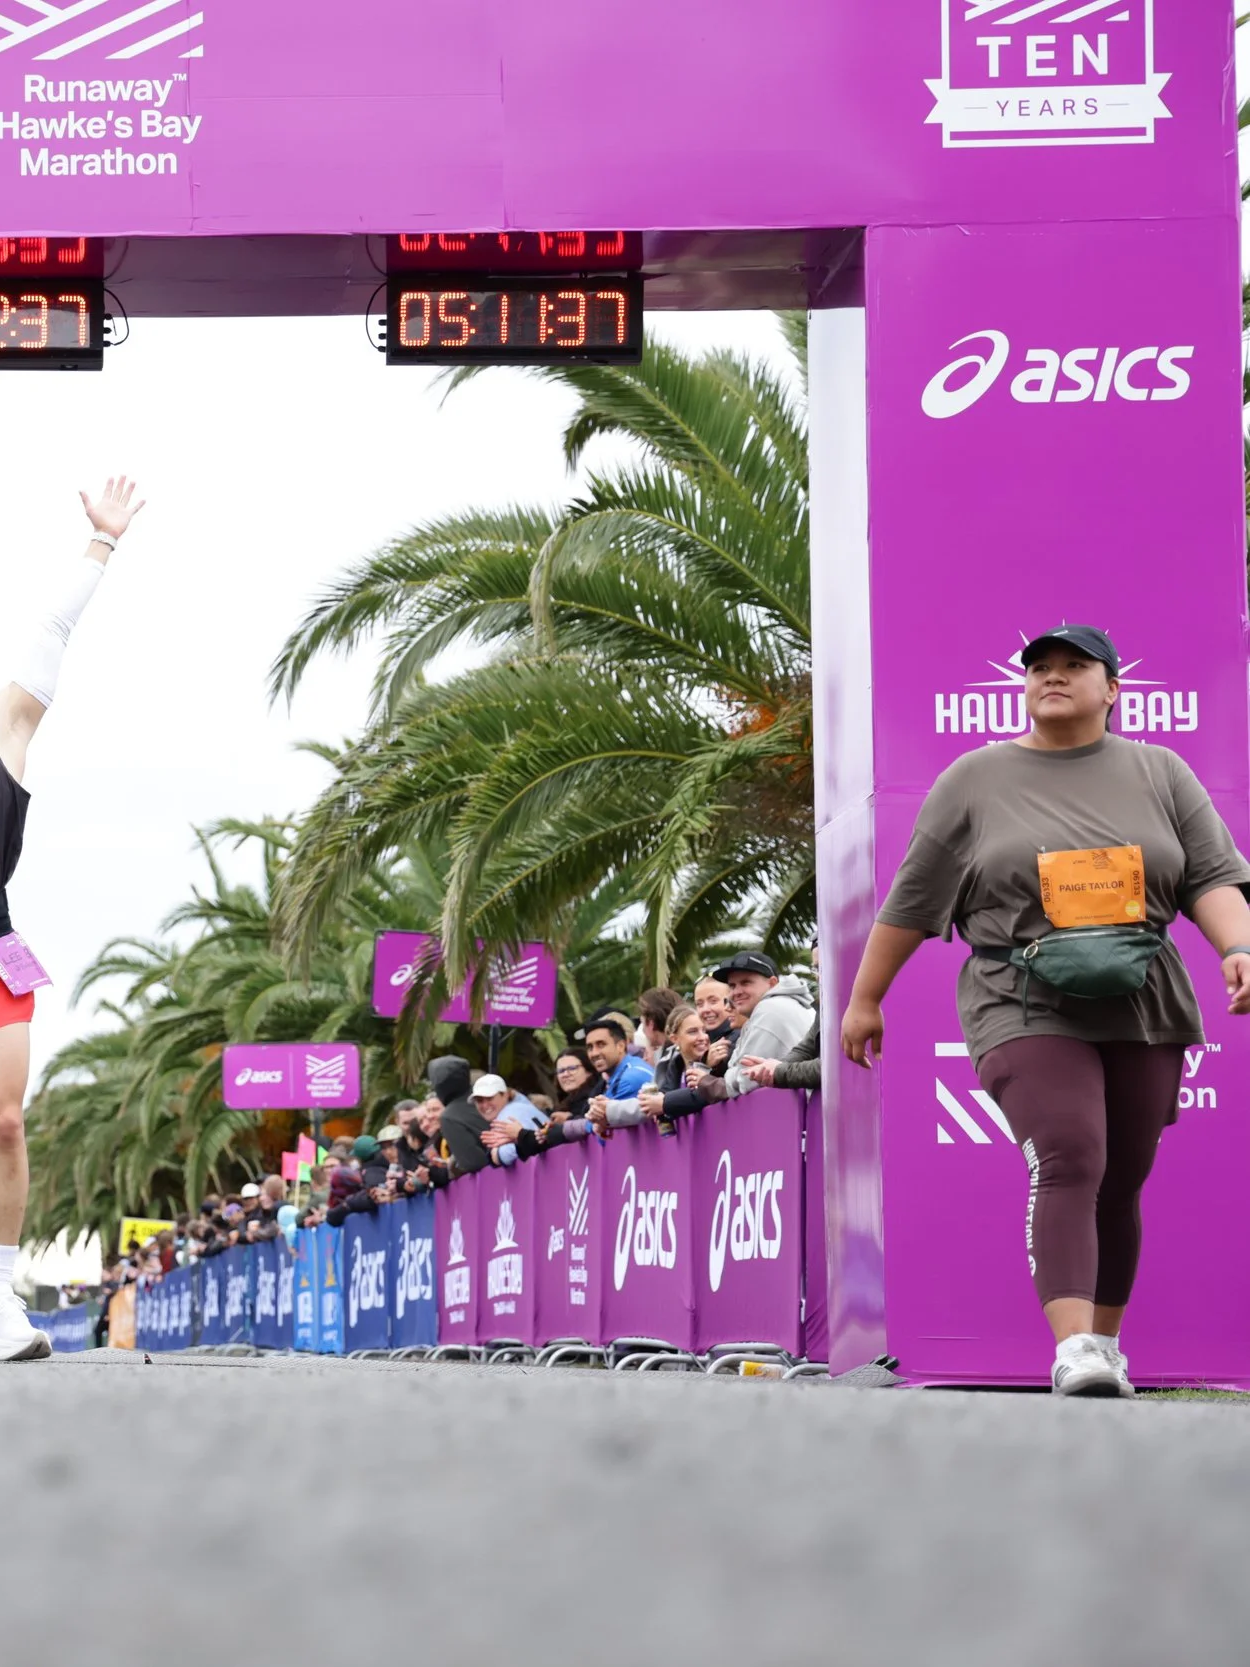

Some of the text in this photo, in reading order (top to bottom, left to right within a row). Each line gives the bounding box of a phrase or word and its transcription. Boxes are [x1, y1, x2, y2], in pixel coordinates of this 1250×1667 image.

[976, 33, 1108, 78] TEN
[141, 110, 203, 144] Bay
[996, 98, 1099, 118] YEARS
[20, 147, 178, 176] Marathon
[400, 292, 625, 347] 05:11:37
[1010, 346, 1195, 403] asics
[1120, 692, 1198, 732] BAY
[1059, 880, 1125, 892] PAIGE TAYLOR
[634, 1191, 679, 1270] asics
[730, 1170, 784, 1261] asics
